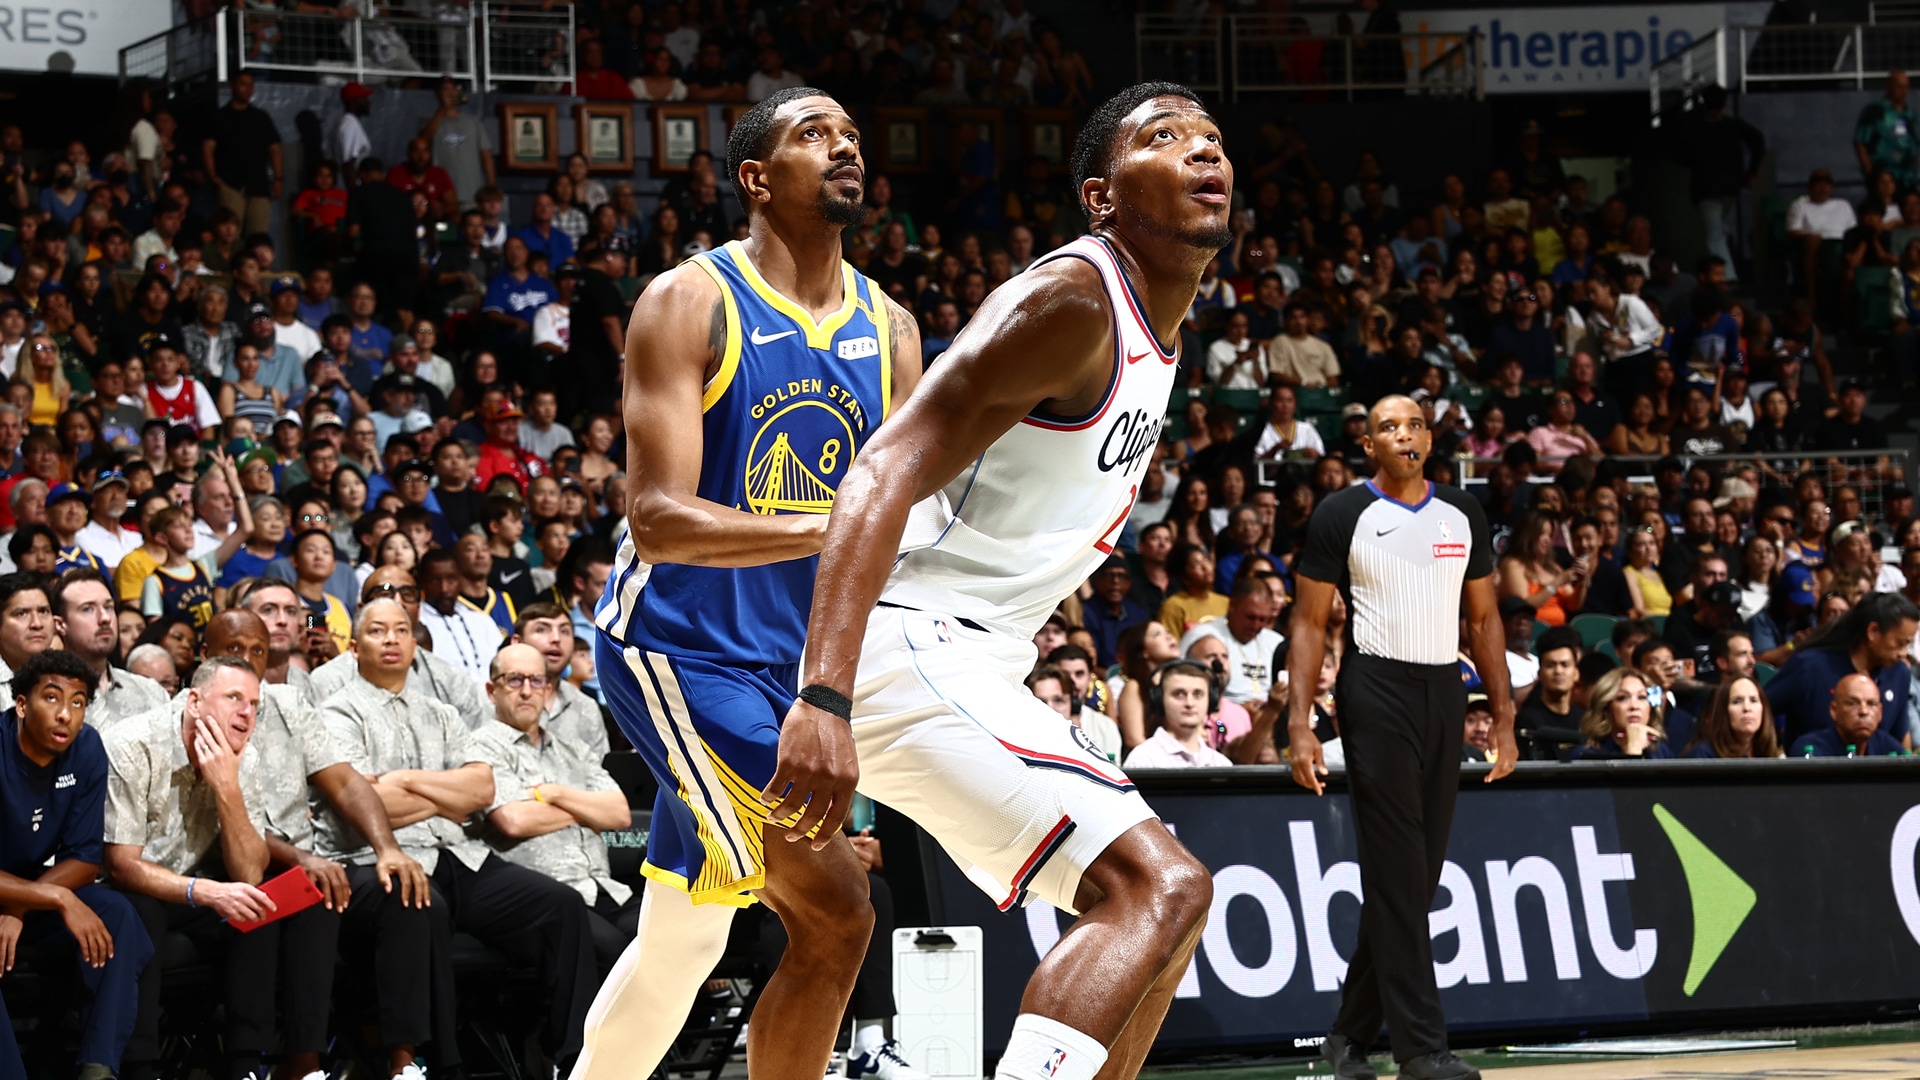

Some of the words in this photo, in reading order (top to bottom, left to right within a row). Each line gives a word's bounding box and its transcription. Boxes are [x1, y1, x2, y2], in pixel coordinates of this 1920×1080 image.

[842, 342, 874, 356] IREN
[750, 378, 823, 420] GOLDEN
[827, 384, 864, 432] STATE
[818, 438, 841, 475] 8
